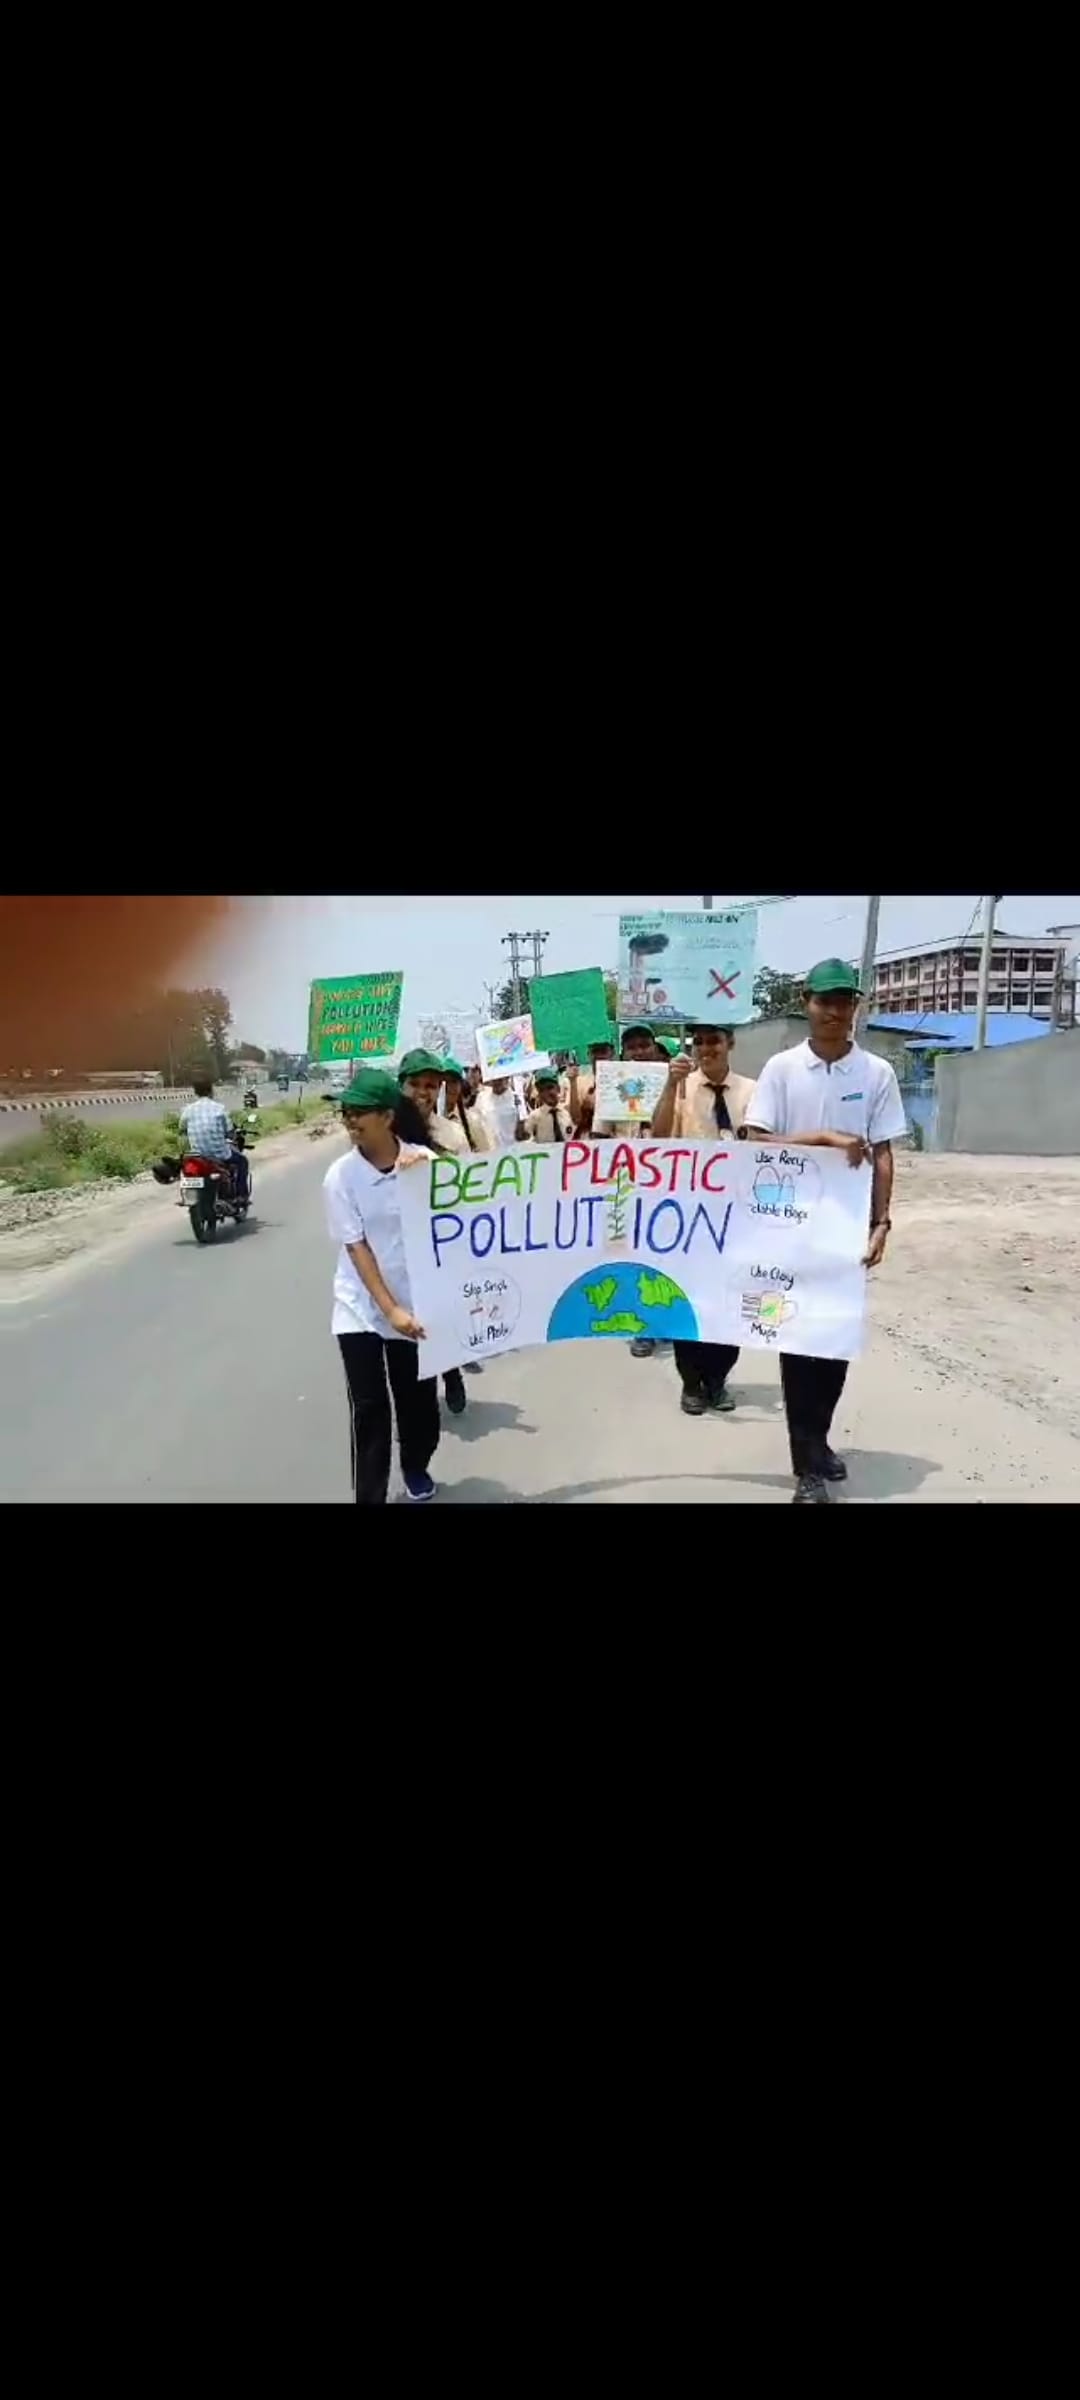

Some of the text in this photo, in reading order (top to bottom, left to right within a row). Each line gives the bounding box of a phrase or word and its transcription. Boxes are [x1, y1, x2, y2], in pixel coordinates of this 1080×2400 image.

[430, 1141, 728, 1210] BEAT PLASTIC
[755, 1151, 775, 1163] Use
[431, 1197, 733, 1268] POLLUTION
[750, 1264, 794, 1291] Use Clay
